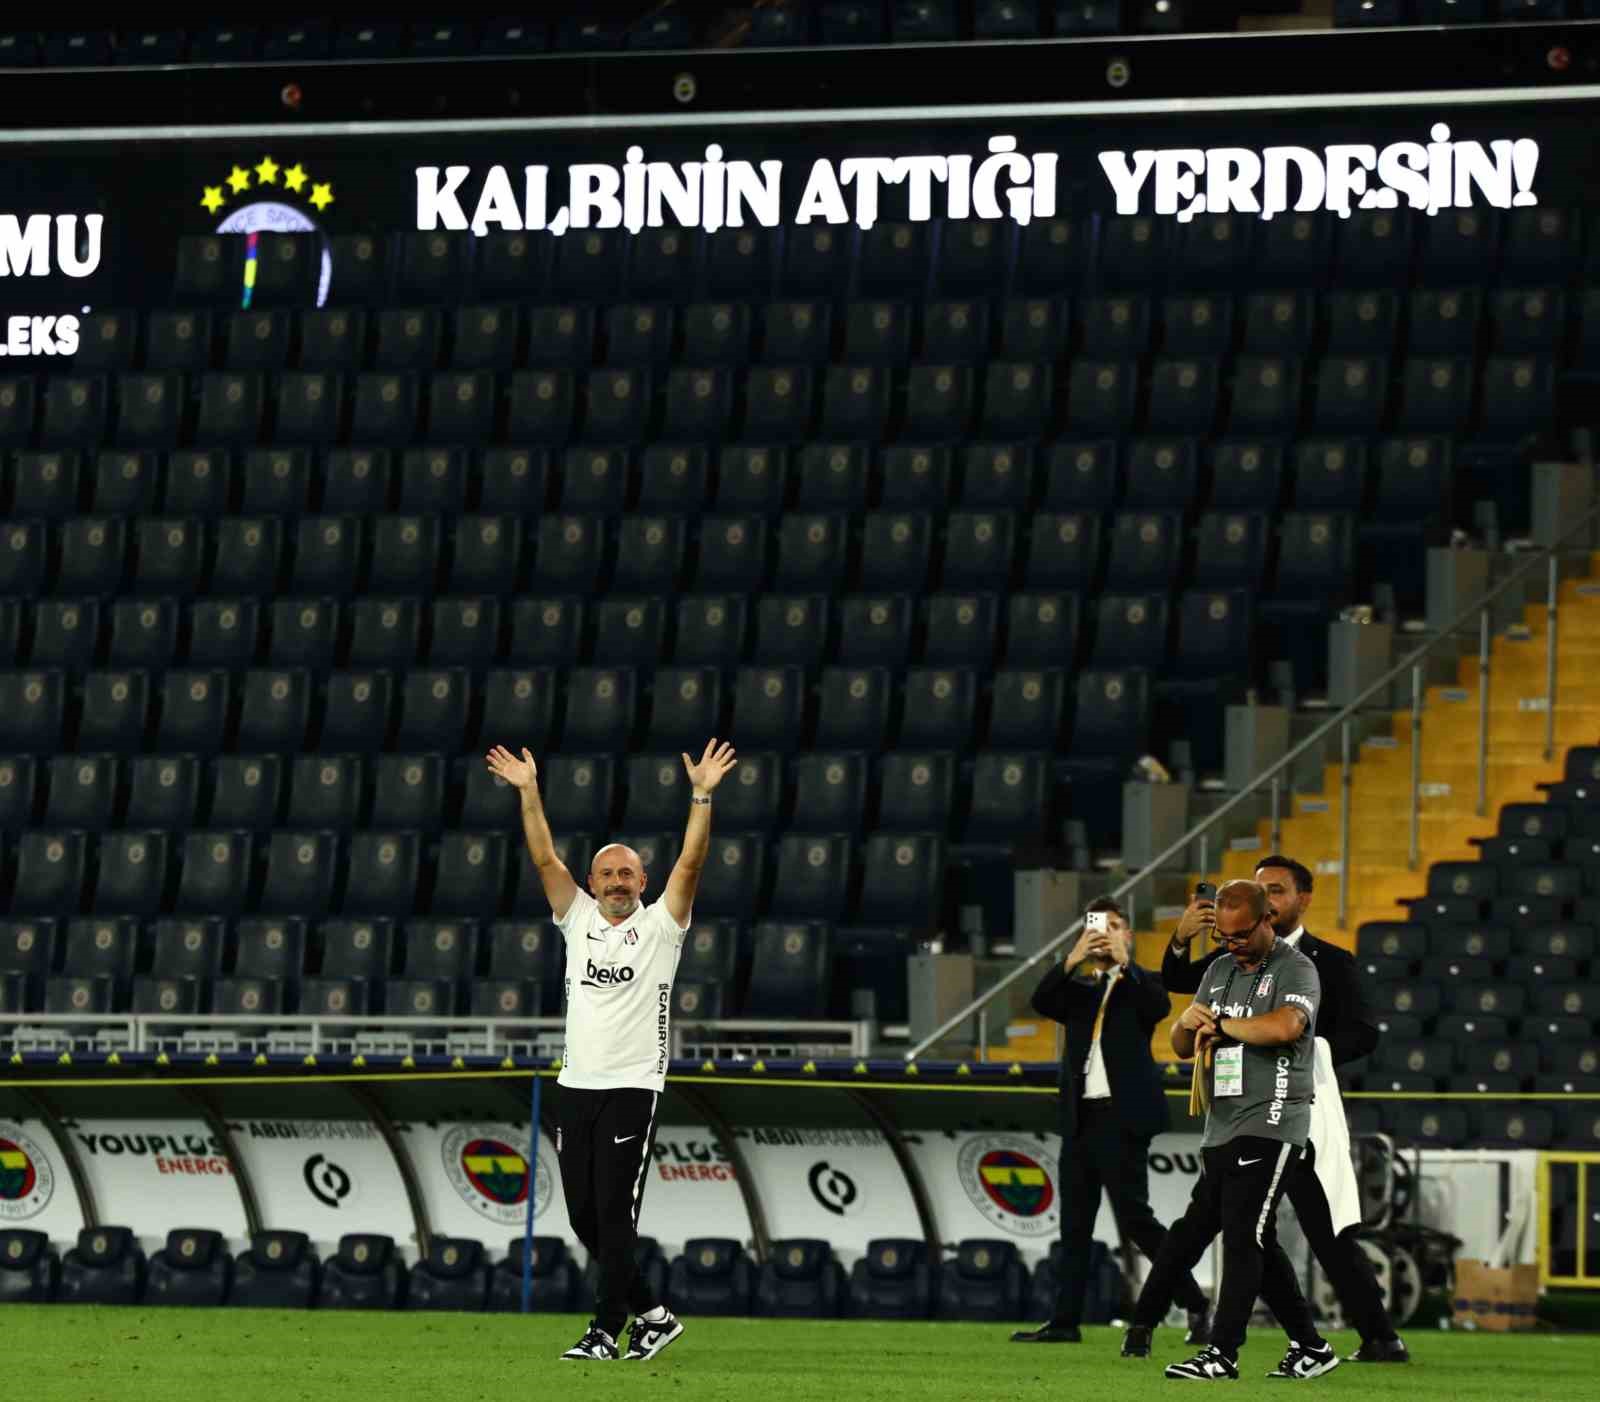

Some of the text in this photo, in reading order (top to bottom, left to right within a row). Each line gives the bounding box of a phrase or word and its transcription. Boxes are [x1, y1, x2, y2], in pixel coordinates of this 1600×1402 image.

[415, 122, 1540, 237] KALBİNİN ATTIĞI YERDESİN!
[0, 213, 104, 278] MU
[0, 312, 84, 356] EKS
[586, 958, 634, 984] beko
